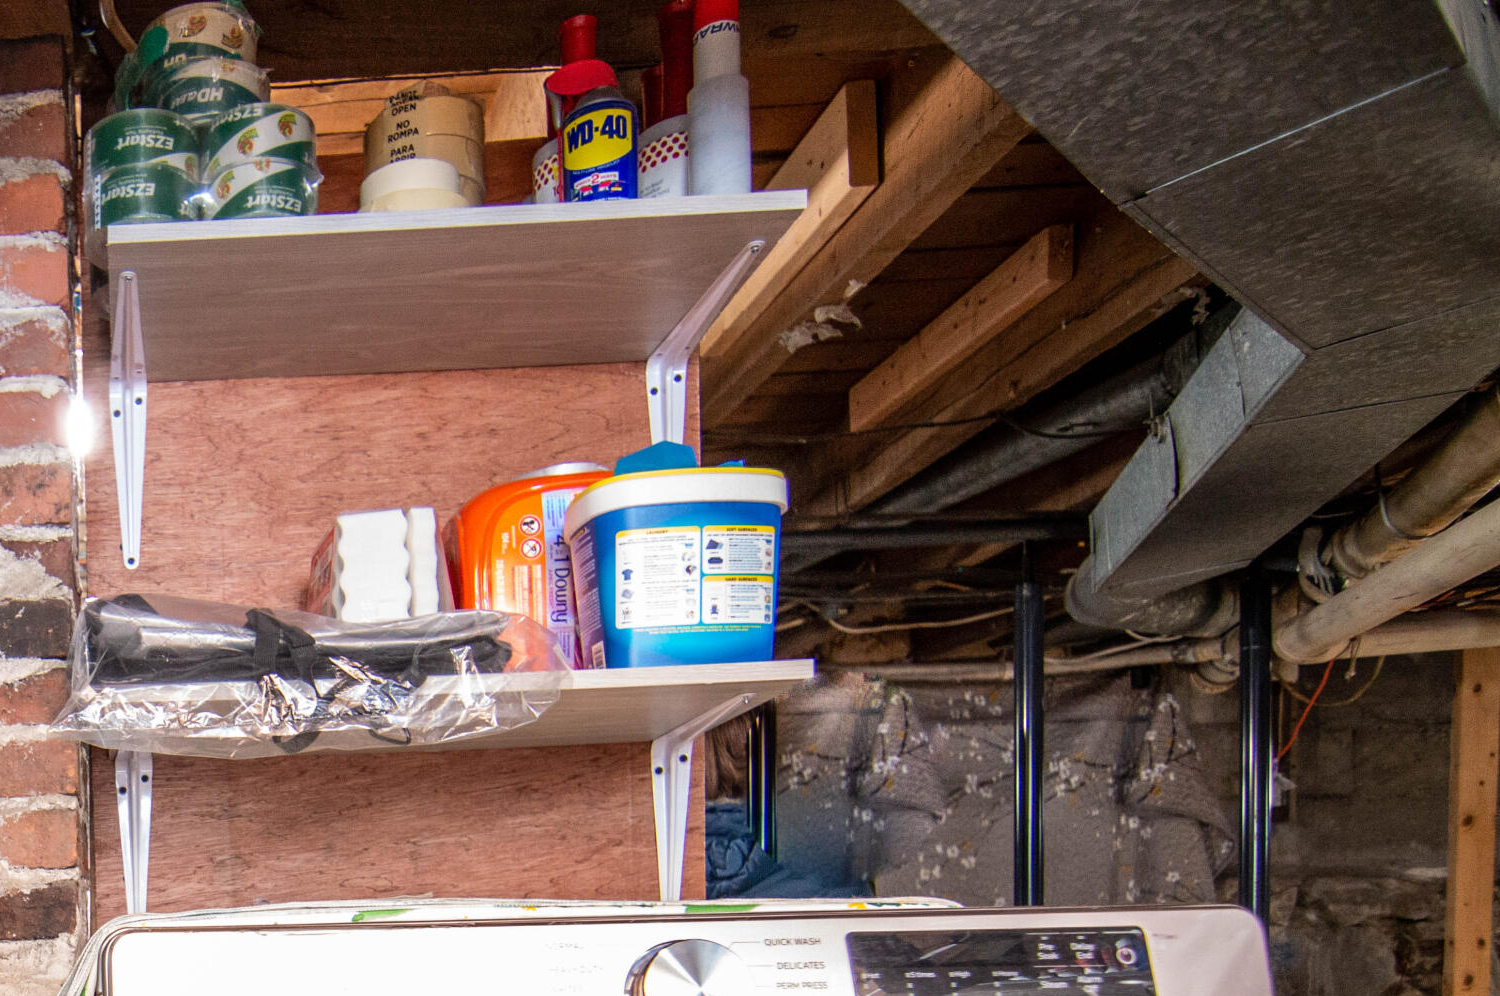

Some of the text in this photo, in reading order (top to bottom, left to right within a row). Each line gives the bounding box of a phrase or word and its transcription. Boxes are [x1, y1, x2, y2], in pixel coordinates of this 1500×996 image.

[391, 103, 417, 117] OPEN
[396, 119, 410, 131] NO
[387, 128, 419, 144] ROMPA
[566, 113, 629, 154] WD-40
[116, 134, 175, 151] EZStart
[390, 144, 415, 158] PARA
[101, 182, 156, 203] EZStart
[245, 194, 302, 212] EZStart
[550, 567, 570, 623] Downy
[764, 937, 822, 947] QUICK WASH
[776, 961, 826, 970] DELICATES
